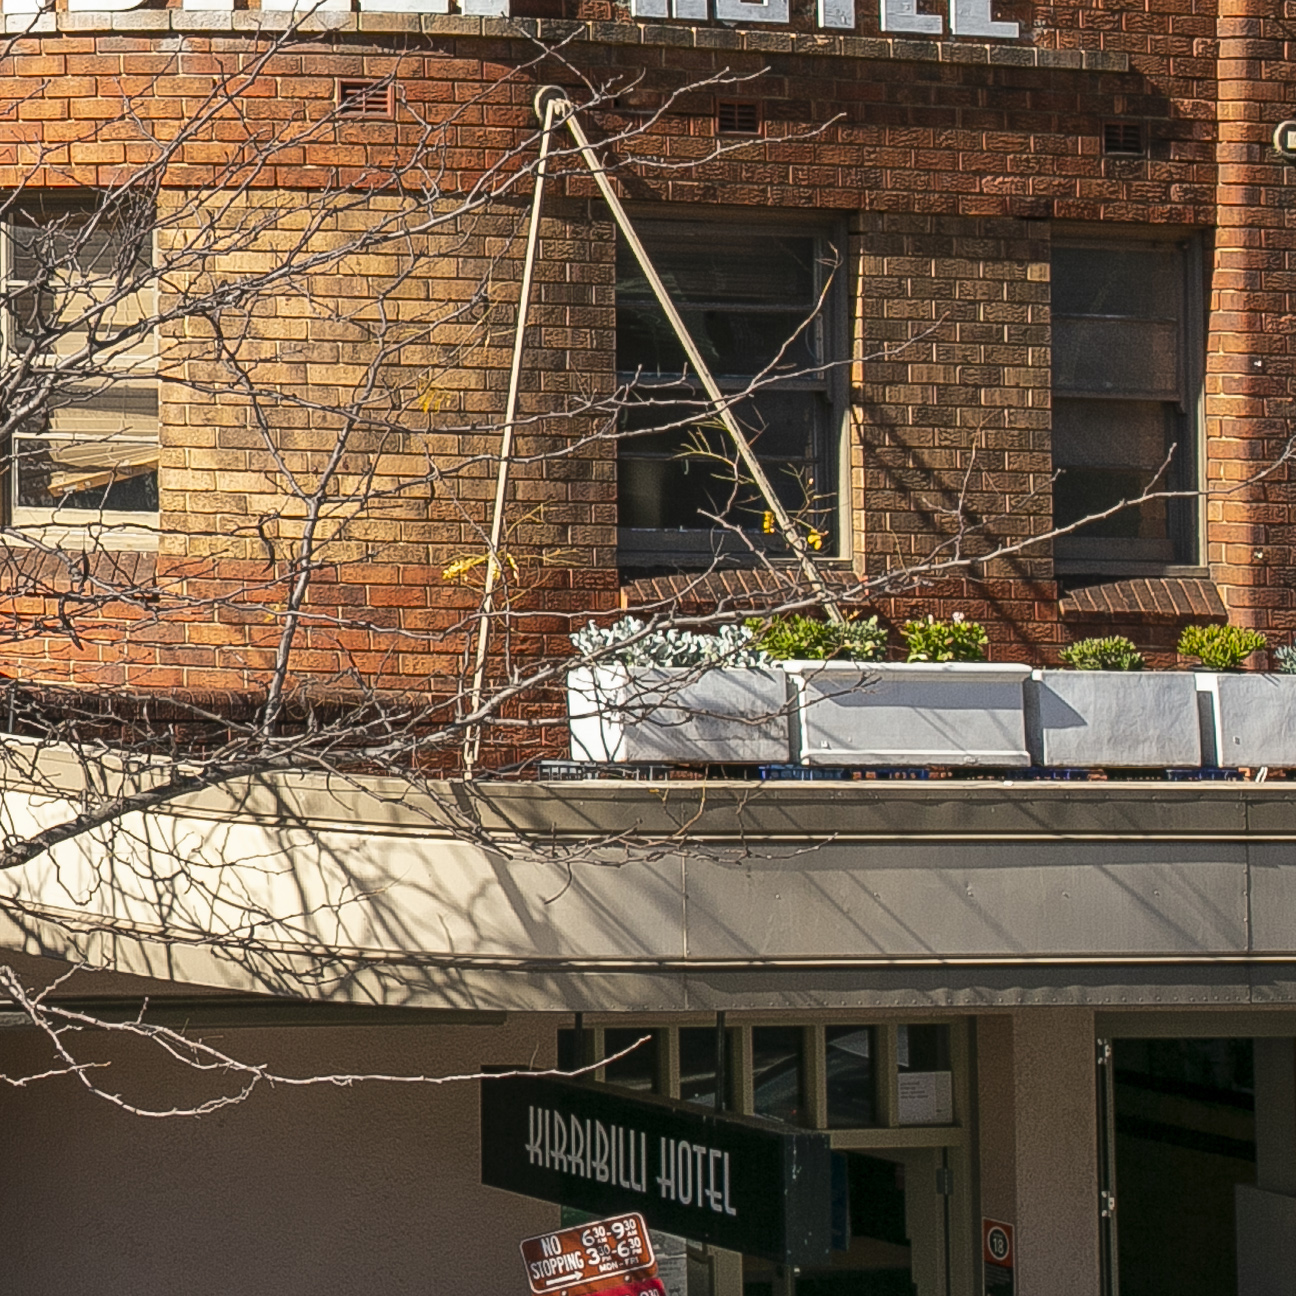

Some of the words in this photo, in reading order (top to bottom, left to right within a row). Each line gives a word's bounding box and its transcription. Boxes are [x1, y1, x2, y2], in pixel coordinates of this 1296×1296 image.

[524, 1105, 647, 1193] KIRRIBILLI
[656, 1136, 737, 1216] HOTEL
[540, 1235, 562, 1257] NO
[992, 1237, 1005, 1255] 18
[530, 1251, 584, 1280] STOPPING
